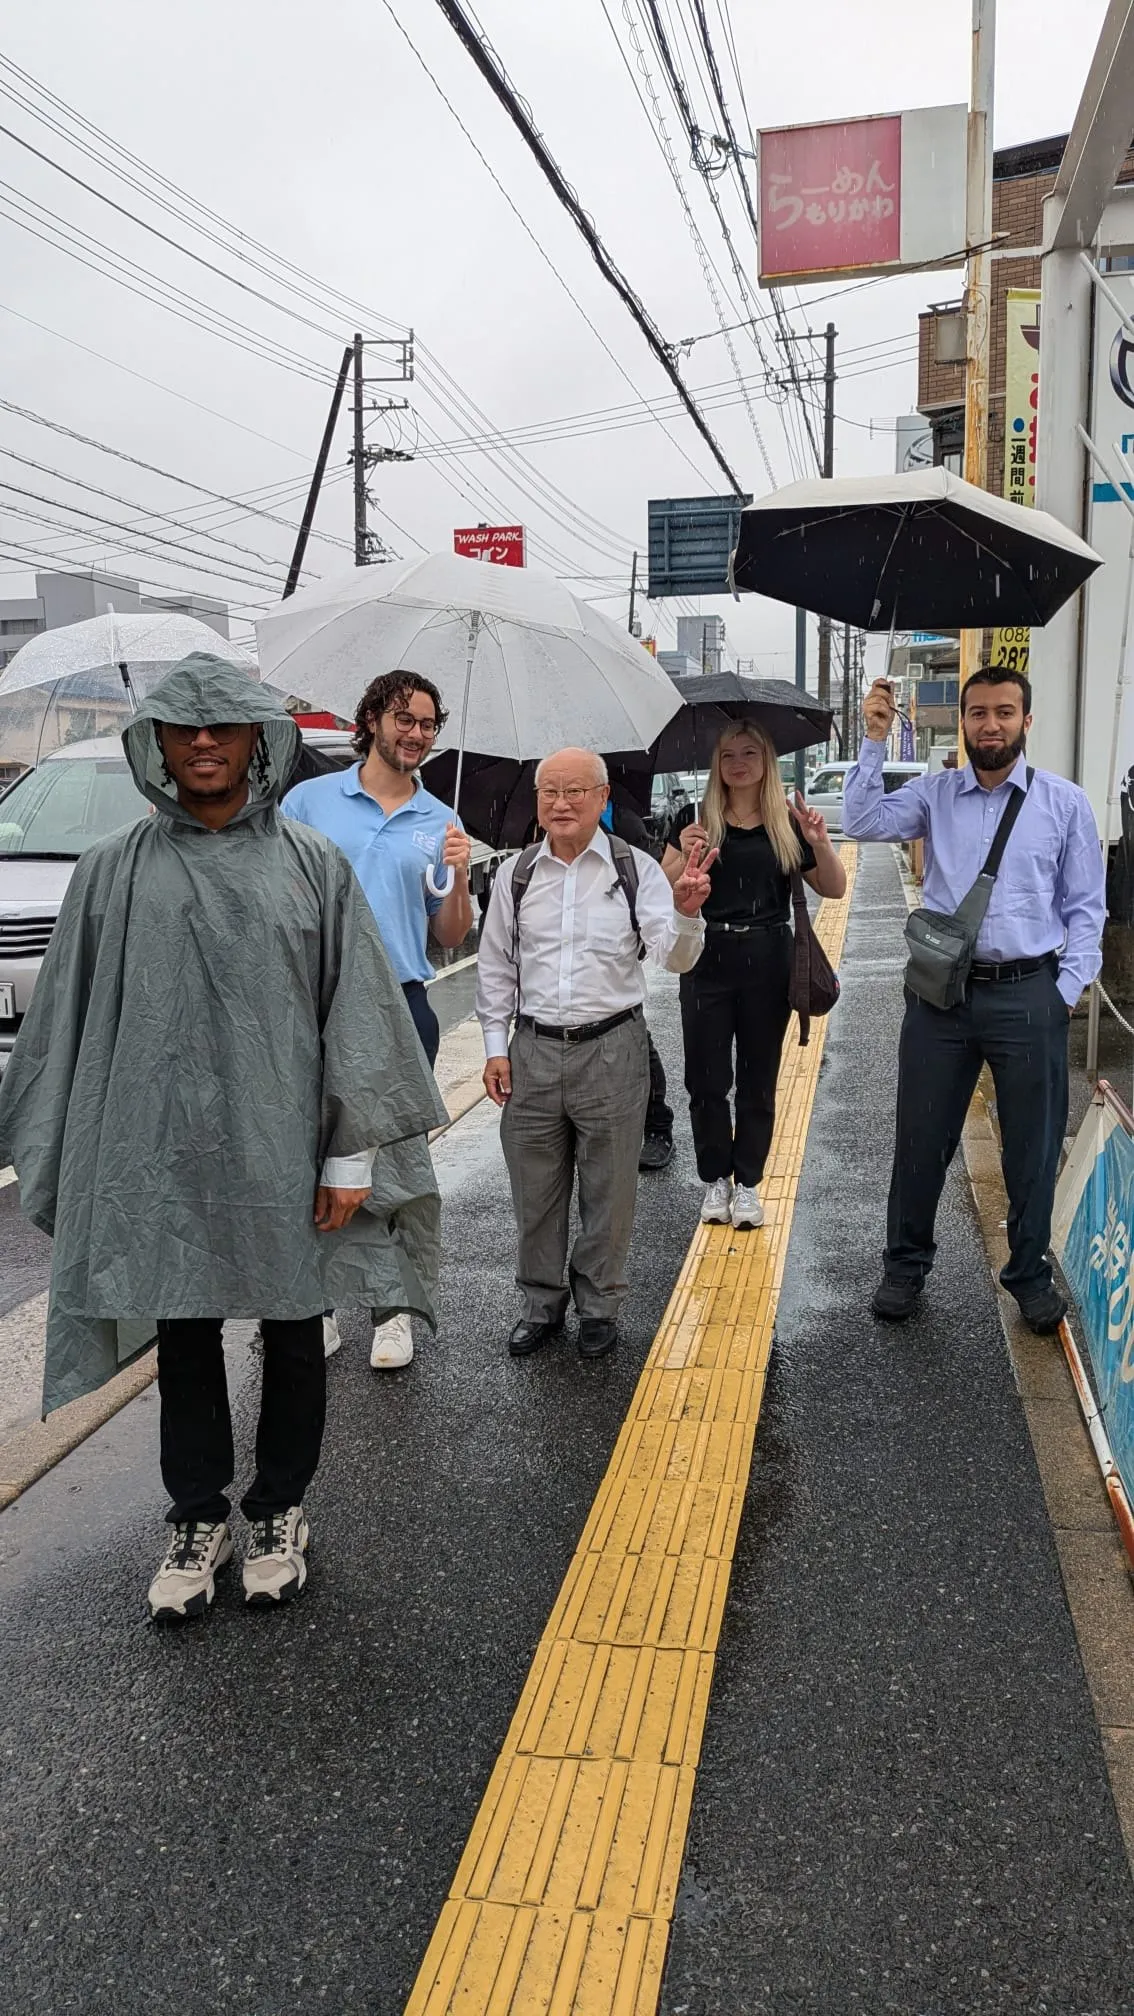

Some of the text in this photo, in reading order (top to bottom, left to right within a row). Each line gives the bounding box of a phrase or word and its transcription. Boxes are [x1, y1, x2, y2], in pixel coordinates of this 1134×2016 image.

[455, 532, 523, 544] WASH PARK
[469, 546, 508, 561] コイン
